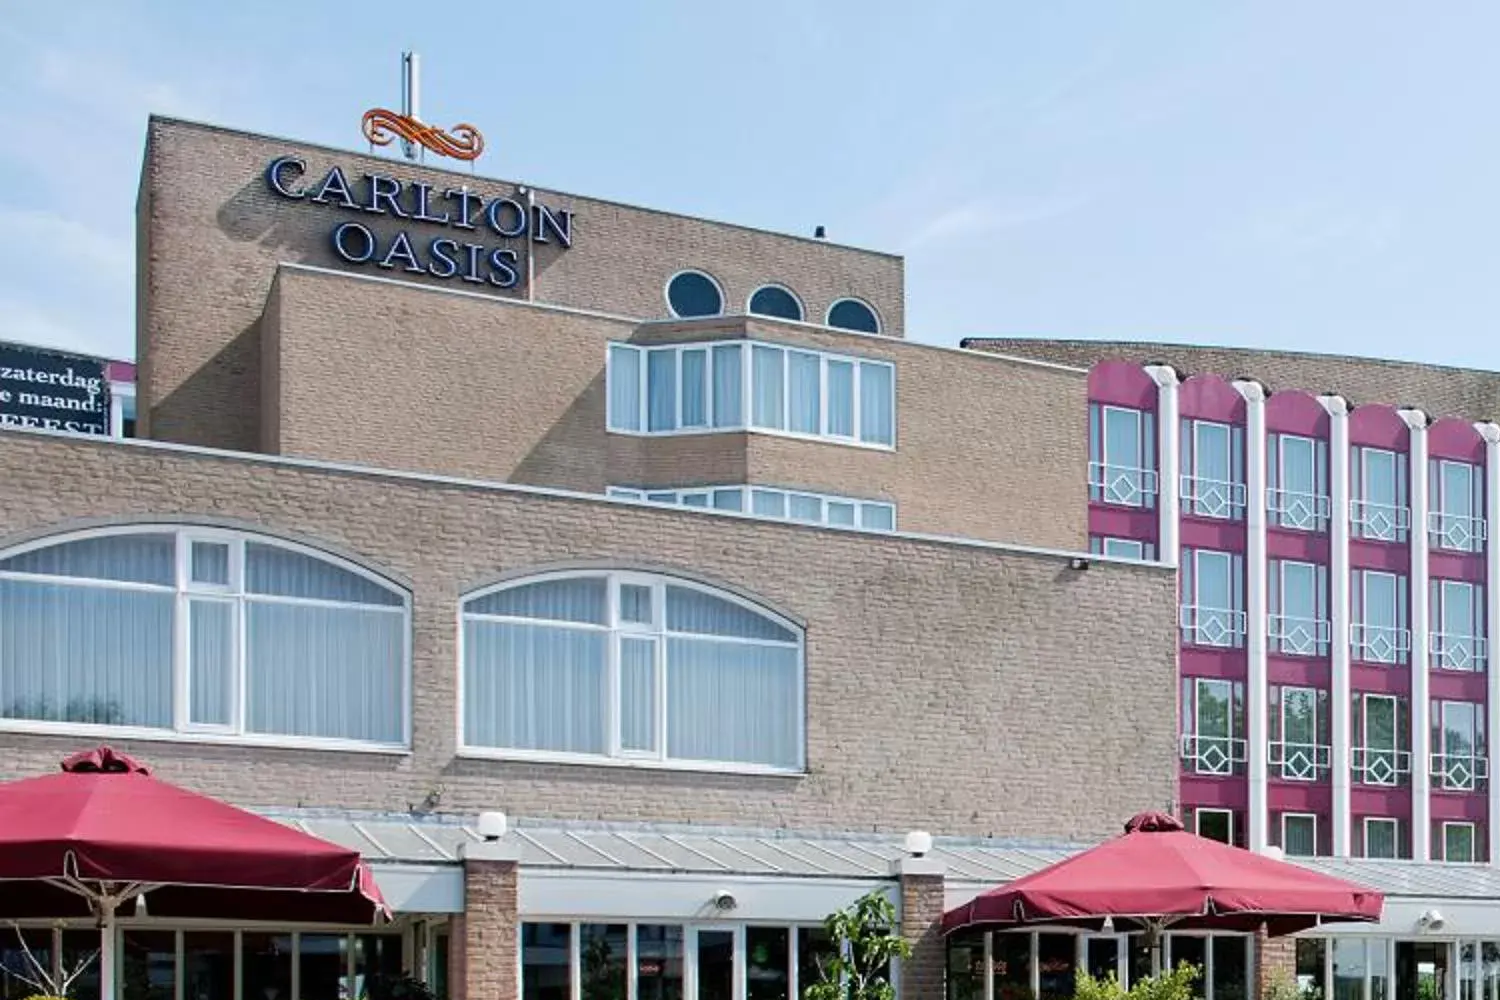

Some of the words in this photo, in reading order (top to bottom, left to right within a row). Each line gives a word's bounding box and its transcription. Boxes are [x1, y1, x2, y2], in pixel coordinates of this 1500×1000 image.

[267, 155, 575, 248] CARLTON
[333, 221, 520, 289] OASIS
[0, 367, 101, 394] zaterdag
[19, 391, 102, 412] maand:
